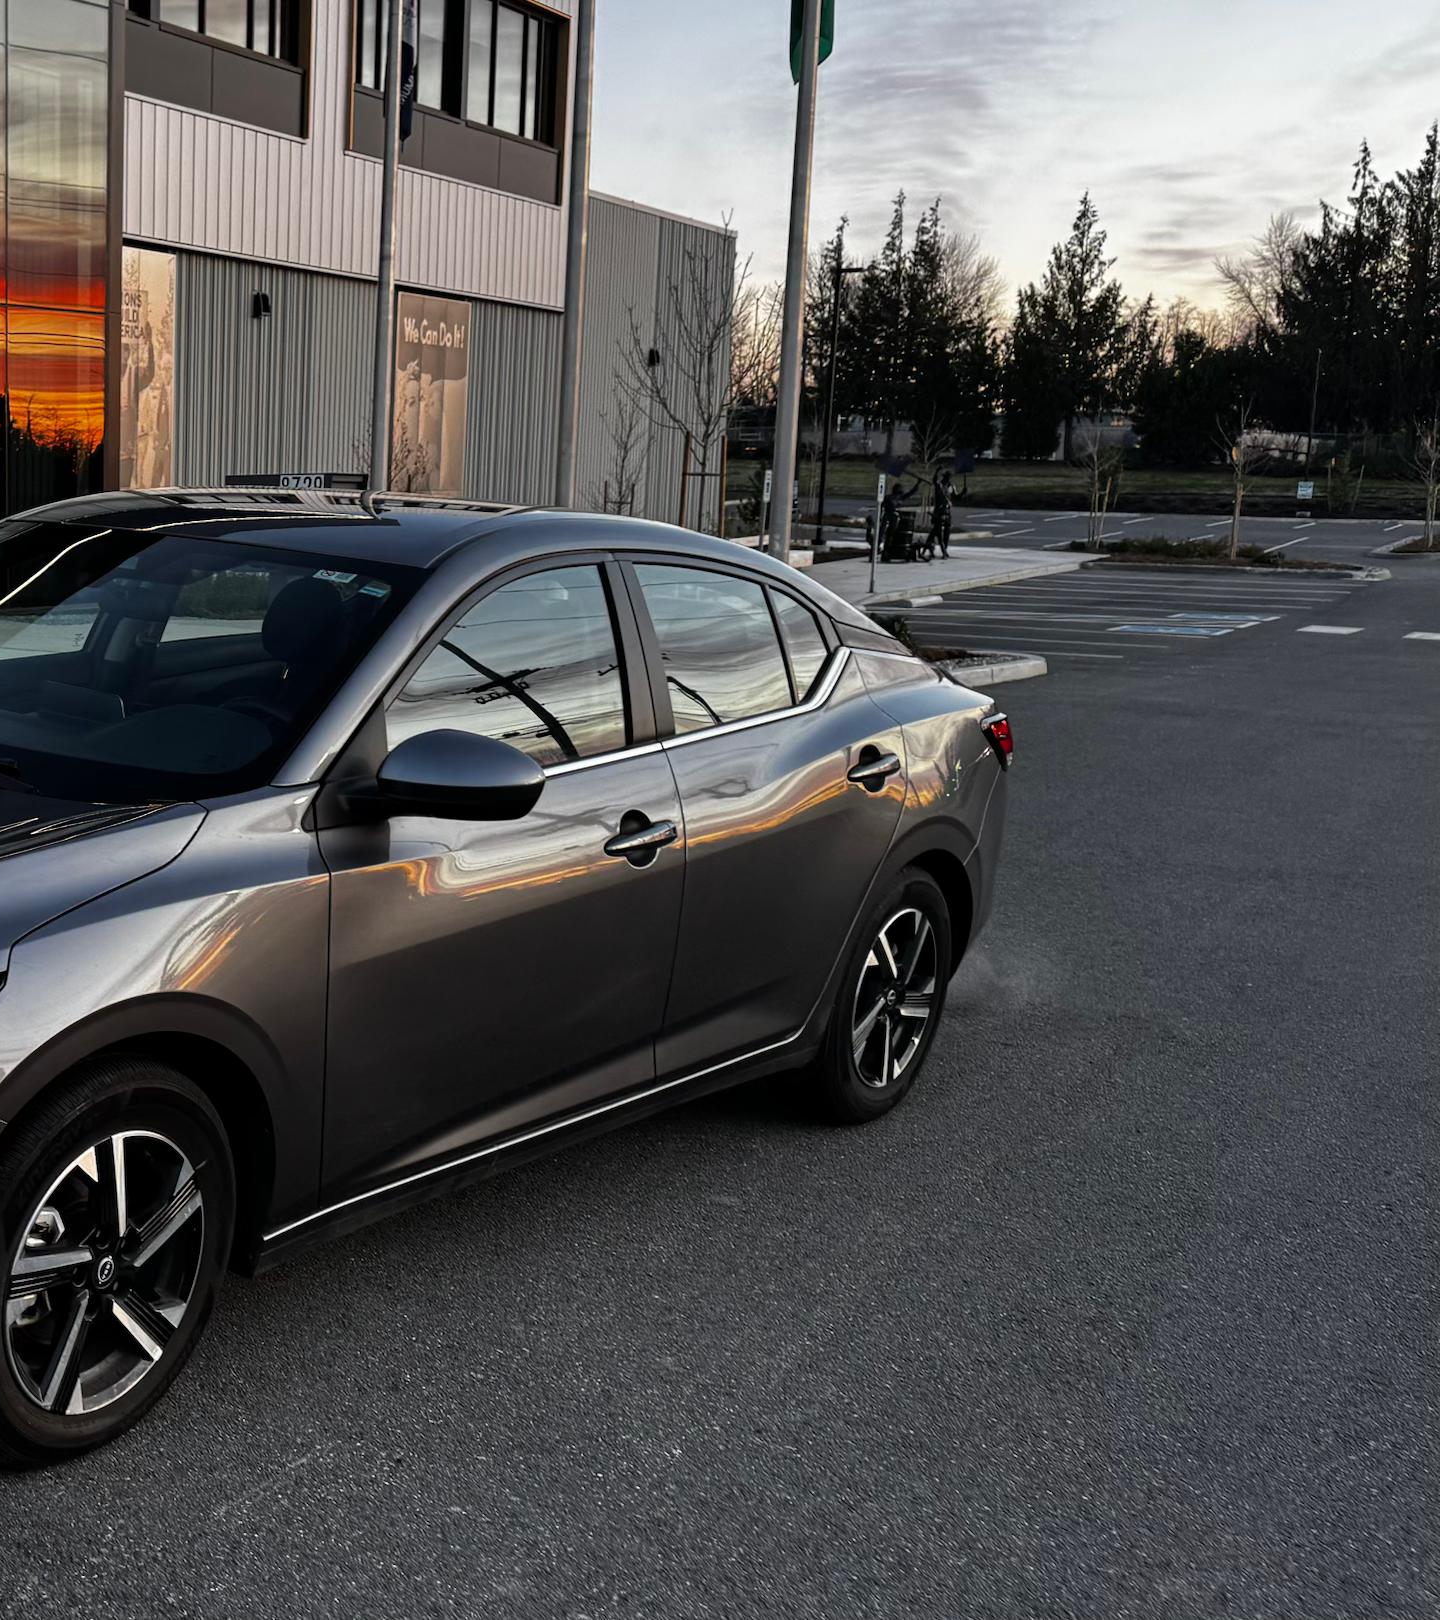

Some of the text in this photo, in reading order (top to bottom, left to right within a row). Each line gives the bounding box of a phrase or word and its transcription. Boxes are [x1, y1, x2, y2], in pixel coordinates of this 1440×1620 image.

[404, 317, 465, 349] We Can Do It!
